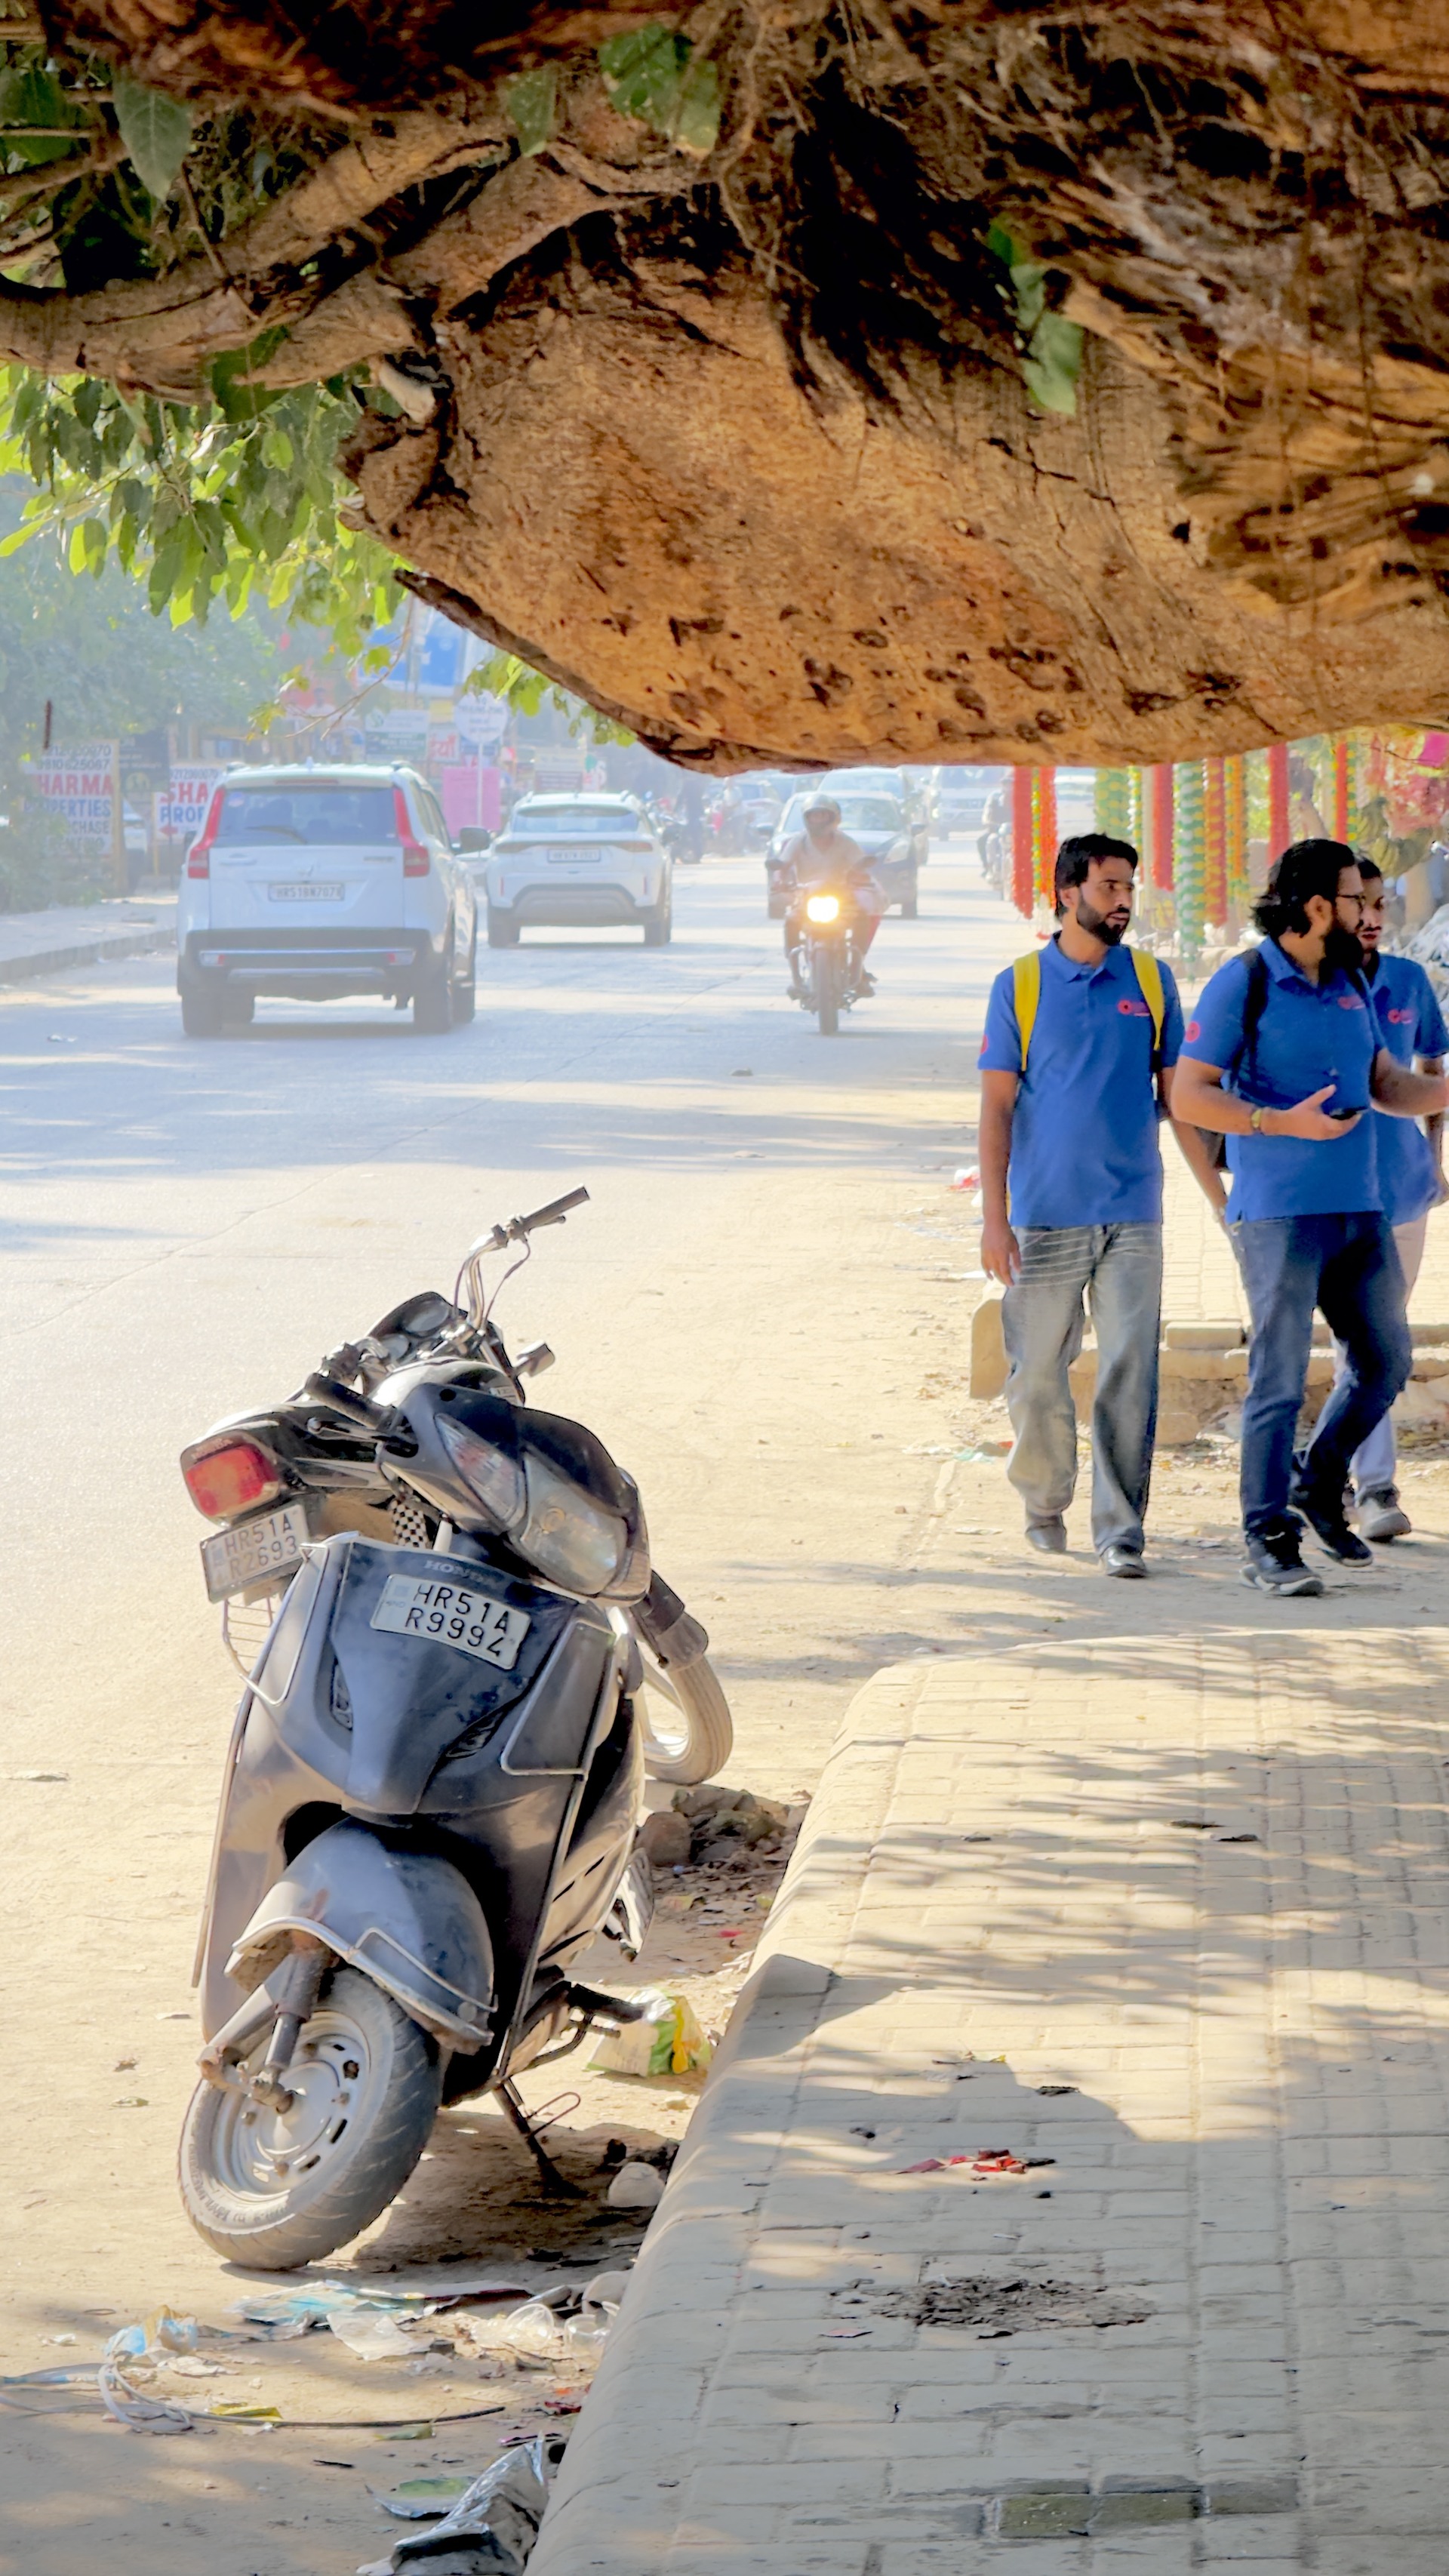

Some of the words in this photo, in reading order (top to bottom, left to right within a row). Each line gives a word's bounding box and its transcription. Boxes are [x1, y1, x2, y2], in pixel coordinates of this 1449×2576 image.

[35, 774, 114, 796] HARMA
[224, 1513, 293, 1557] HR51A
[229, 1534, 297, 1580] R2693
[405, 1606, 508, 1657] R9994
[412, 1583, 509, 1634] HR51A
